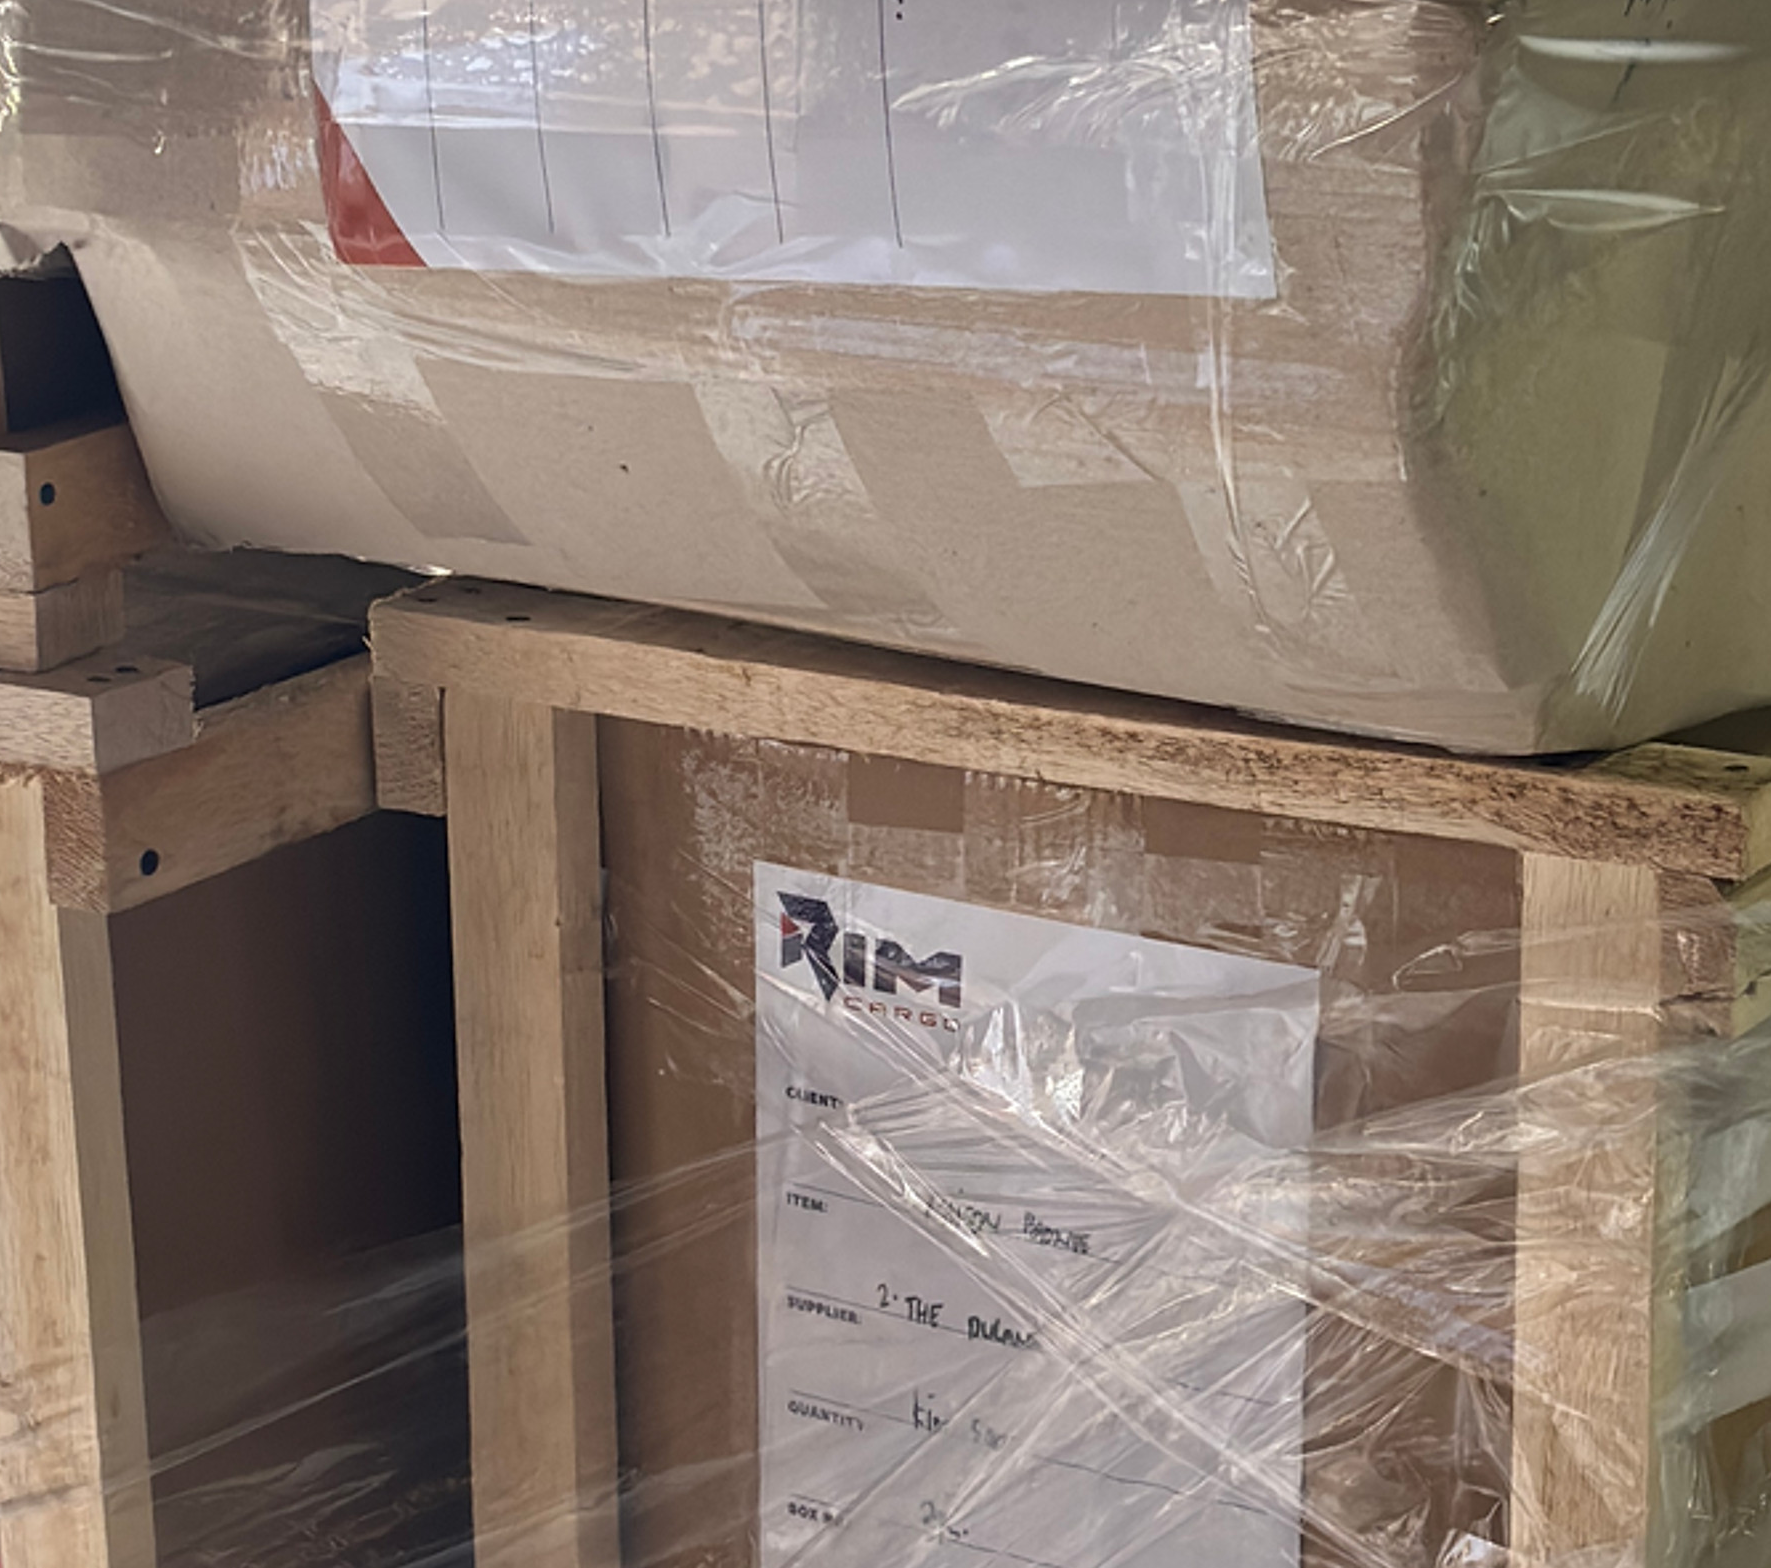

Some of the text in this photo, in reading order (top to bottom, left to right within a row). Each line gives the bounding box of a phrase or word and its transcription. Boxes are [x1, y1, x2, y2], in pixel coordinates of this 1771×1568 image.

[777, 891, 962, 1009] RIM
[843, 996, 961, 1033] CARGO
[786, 1192, 829, 1213] ITEM:
[786, 1294, 862, 1325] SUPPLIER:
